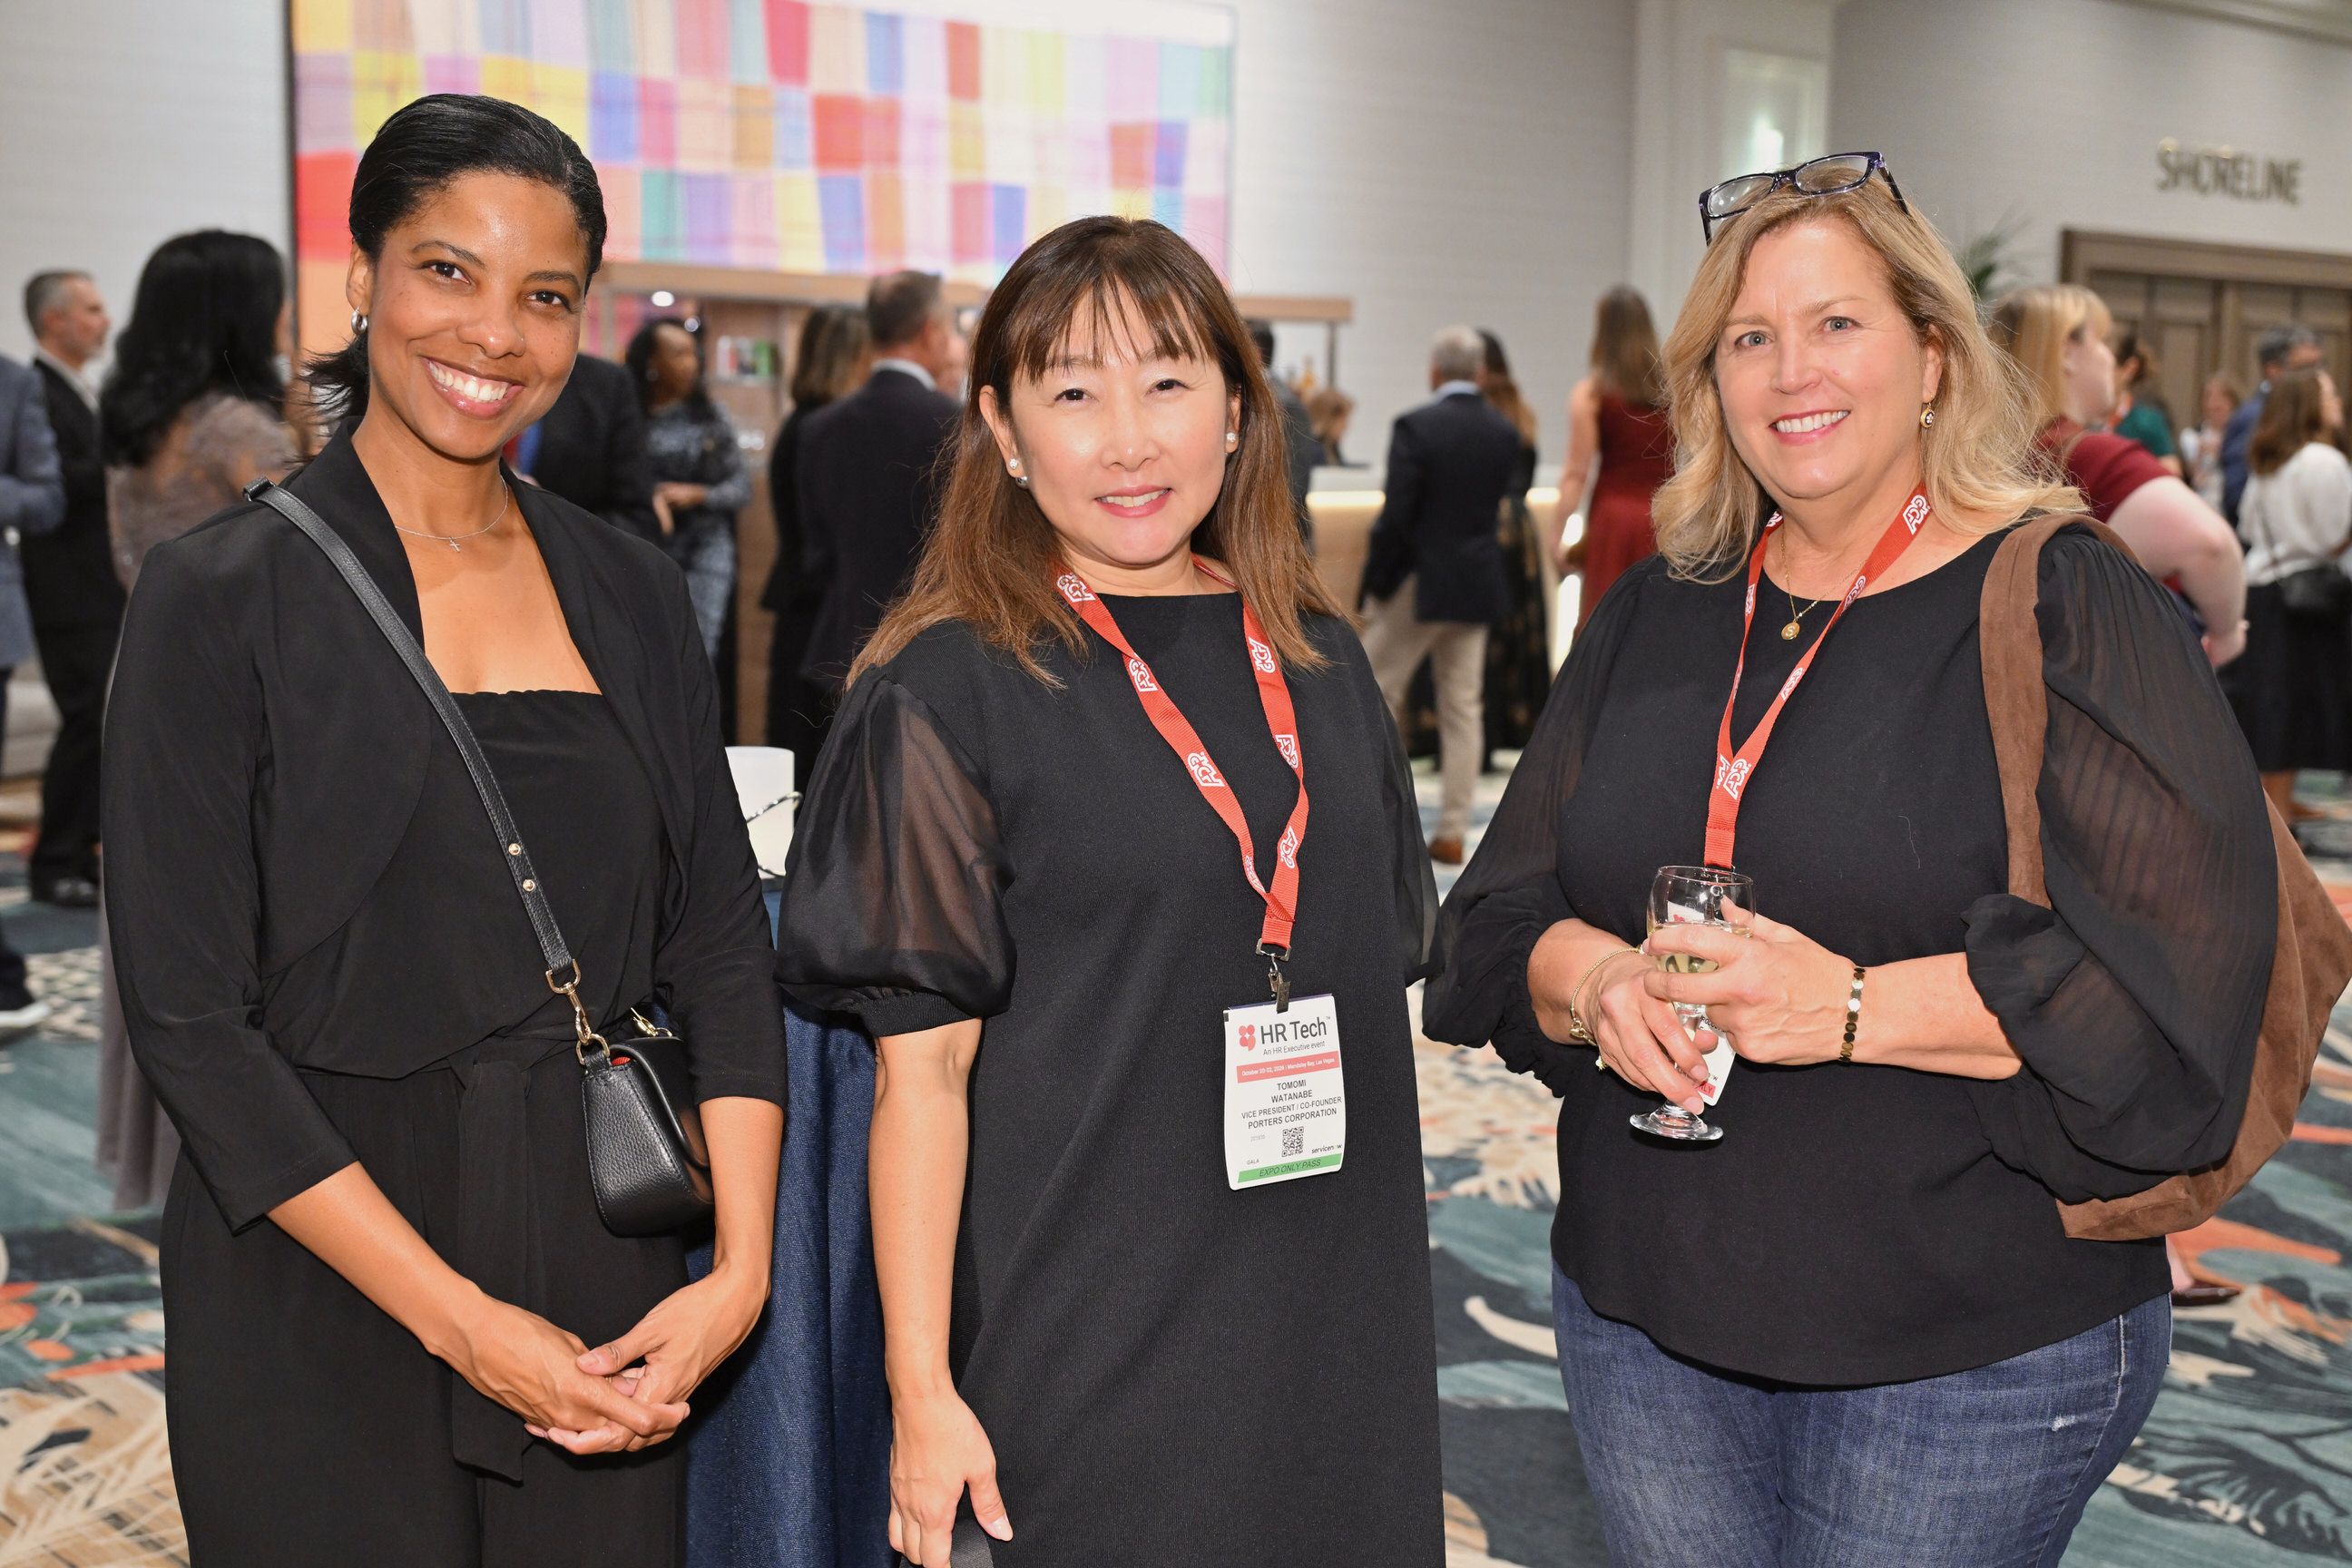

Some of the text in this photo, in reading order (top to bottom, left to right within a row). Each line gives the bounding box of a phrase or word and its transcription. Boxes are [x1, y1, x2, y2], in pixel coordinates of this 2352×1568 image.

[1249, 636, 1275, 673] ADP
[1187, 751, 1225, 787] ADP
[1723, 759, 1752, 800] ADP
[1260, 1023, 1288, 1044] HR
[1289, 1016, 1327, 1040] Tech
[1283, 1044, 1310, 1054] Executive
[1310, 1041, 1326, 1049] event
[1271, 1089, 1313, 1103] WATANABE
[1278, 1079, 1307, 1091] TOMOMI
[1241, 1110, 1257, 1119] VICE
[1259, 1104, 1295, 1116] PRESIDENT
[1299, 1096, 1342, 1110] CO-FOUNDER
[1248, 1107, 1338, 1129] PORTERS CORPORATION
[1259, 1159, 1321, 1177] EXPO ONLY PASS
